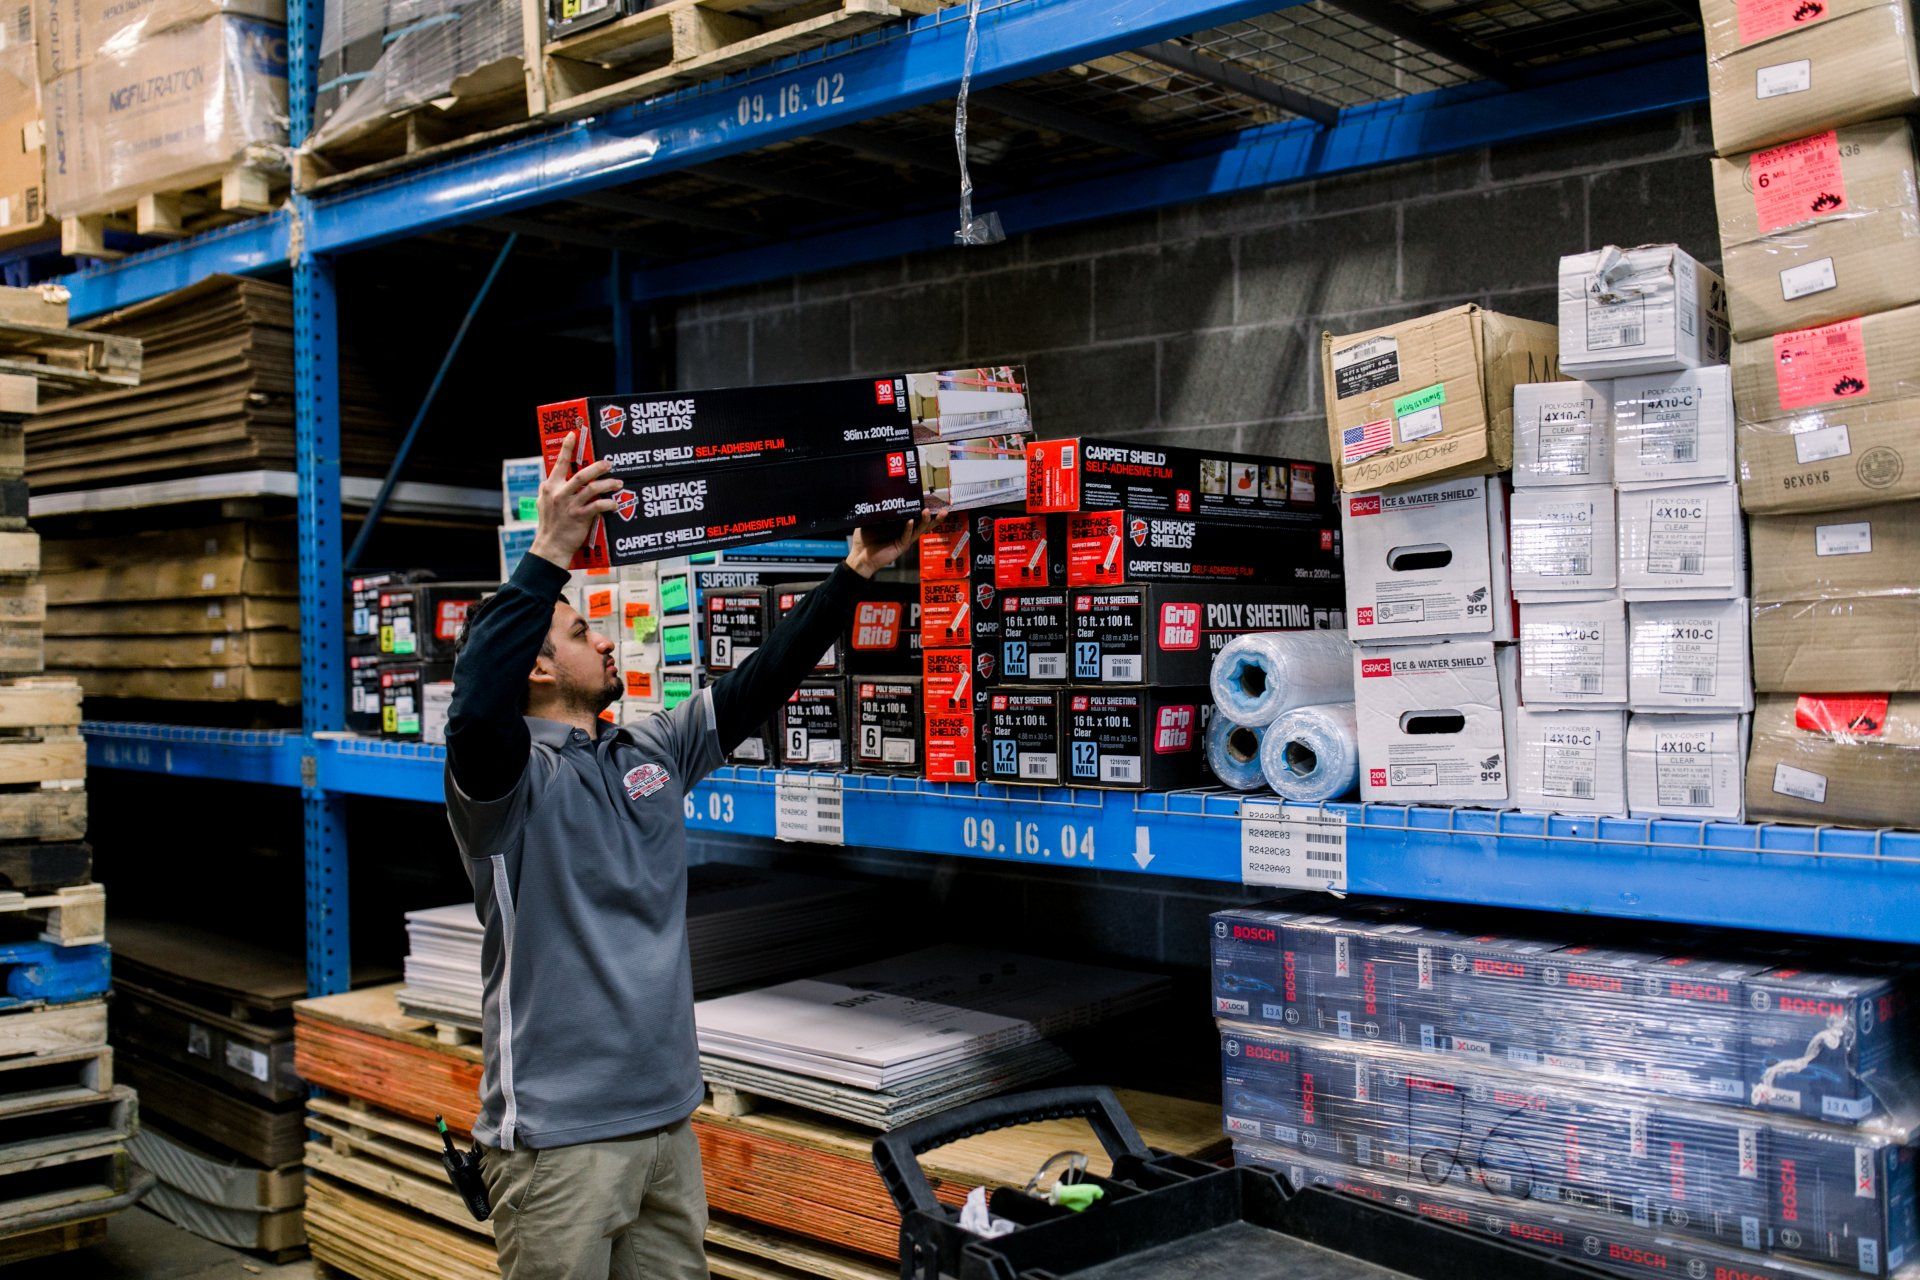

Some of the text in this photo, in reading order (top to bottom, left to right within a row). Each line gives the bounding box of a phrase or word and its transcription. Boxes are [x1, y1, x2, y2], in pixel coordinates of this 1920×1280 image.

[1758, 174, 1770, 188] 6
[1772, 170, 1786, 178] MIL
[878, 384, 891, 395] 30
[1648, 386, 1692, 395] POLY-COVER
[630, 399, 696, 419] SURFACE
[1544, 401, 1584, 409] POLY-COVER
[1648, 396, 1693, 409] 4X10-C
[542, 407, 579, 424] SURFACE
[1656, 412, 1681, 420] CLEAR
[632, 415, 692, 435] SHIELDS
[843, 426, 894, 441] 36in 200ft
[603, 438, 785, 466] CARPET SHIELD SELF-ADHESIVE FILM
[1086, 446, 1166, 466] CARPET SHIELD
[890, 456, 902, 467] 30
[1086, 460, 1173, 479] SELF-ADHESIVE FILM
[642, 480, 708, 501] SURFACE
[1178, 493, 1189, 502] 30
[644, 496, 704, 518] SHIELDS
[854, 498, 905, 514] 36in 200ft
[1351, 488, 1475, 512] GRACE ICE & WATER SHIELD
[1656, 508, 1701, 519] 4X10-C
[616, 532, 664, 551] CARPET
[665, 526, 705, 544] SHIELD
[707, 518, 774, 538] SELF-ADHESIVE
[776, 514, 796, 526] FILM
[1151, 520, 1196, 536] SURFACE
[1151, 535, 1192, 549] SHIELDS
[1129, 560, 1239, 576] CARPET SHIELD SELF-ADHESIVE
[702, 573, 760, 588] SUPERTUFF
[925, 585, 960, 594] SURFACE
[1021, 596, 1062, 605] POLY SHEETING
[1110, 596, 1138, 604] SHEETING
[860, 604, 896, 626] Grip
[1164, 606, 1196, 626] Grip
[1207, 604, 1310, 628] POLY SHEETING
[1467, 604, 1487, 614] gcp
[713, 614, 748, 624] 10 100
[1006, 616, 1015, 626] 16
[1033, 616, 1048, 626] 100
[1050, 615, 1058, 626] ft.
[1077, 615, 1133, 627] 16 ft. 100 ft.
[712, 624, 727, 632] Clear
[858, 626, 892, 645] Rite
[1006, 628, 1021, 637] Clear
[1077, 629, 1094, 637] Clear
[1164, 627, 1194, 646] Rite
[716, 638, 726, 657] 6
[1007, 644, 1024, 663] 1.2
[1078, 645, 1097, 664] 1.2
[928, 656, 962, 664] SURFACE
[1362, 657, 1484, 673] GRACE ICE & WATER SHIELD
[1007, 664, 1024, 673] MIL
[1079, 666, 1097, 675] MIL
[862, 703, 898, 713] 10 100
[1106, 697, 1136, 705] SHEETING
[788, 706, 823, 715] 10 100
[862, 714, 876, 722] Clear
[1161, 709, 1190, 727] Grip
[788, 716, 802, 724] Clear
[930, 719, 964, 728] SURFACE
[994, 715, 1047, 725] 16 ft. 100 ft.
[1074, 716, 1131, 727] 16 ft. 100 ft.
[866, 728, 876, 748] 6
[994, 727, 1011, 735] Clear
[1074, 728, 1091, 737] Clear
[1159, 730, 1186, 748] Rite
[792, 730, 801, 749] 6
[1550, 734, 1592, 746] 4X10-C
[1662, 742, 1706, 753] 4X10-C
[996, 742, 1014, 762] 1.2
[1075, 744, 1094, 764] 1.2
[996, 763, 1014, 772] MIL
[1076, 765, 1095, 774] MIL
[1481, 772, 1501, 782] gcp
[1249, 829, 1290, 839] R2420E03
[1249, 846, 1290, 856] R2420C03
[1249, 862, 1290, 874] R2420A03
[1234, 925, 1275, 942] BOSCH
[1285, 951, 1296, 1001] BOSCH
[1473, 959, 1524, 977] BOSCH
[1365, 962, 1376, 1015] BOSCH
[1567, 973, 1622, 992] BOSCH
[1670, 982, 1729, 1003] BOSCH
[1780, 997, 1843, 1018] BOSCH
[1245, 1045, 1290, 1063] BOSCH
[1405, 1076, 1455, 1094] BOSCH
[1303, 1073, 1314, 1125] BOSCH
[1782, 1159, 1797, 1220] BOSCH
[1419, 1203, 1469, 1224] BOSCH
[1510, 1222, 1563, 1246] BOSCH
[1609, 1244, 1666, 1269] BOSCH
